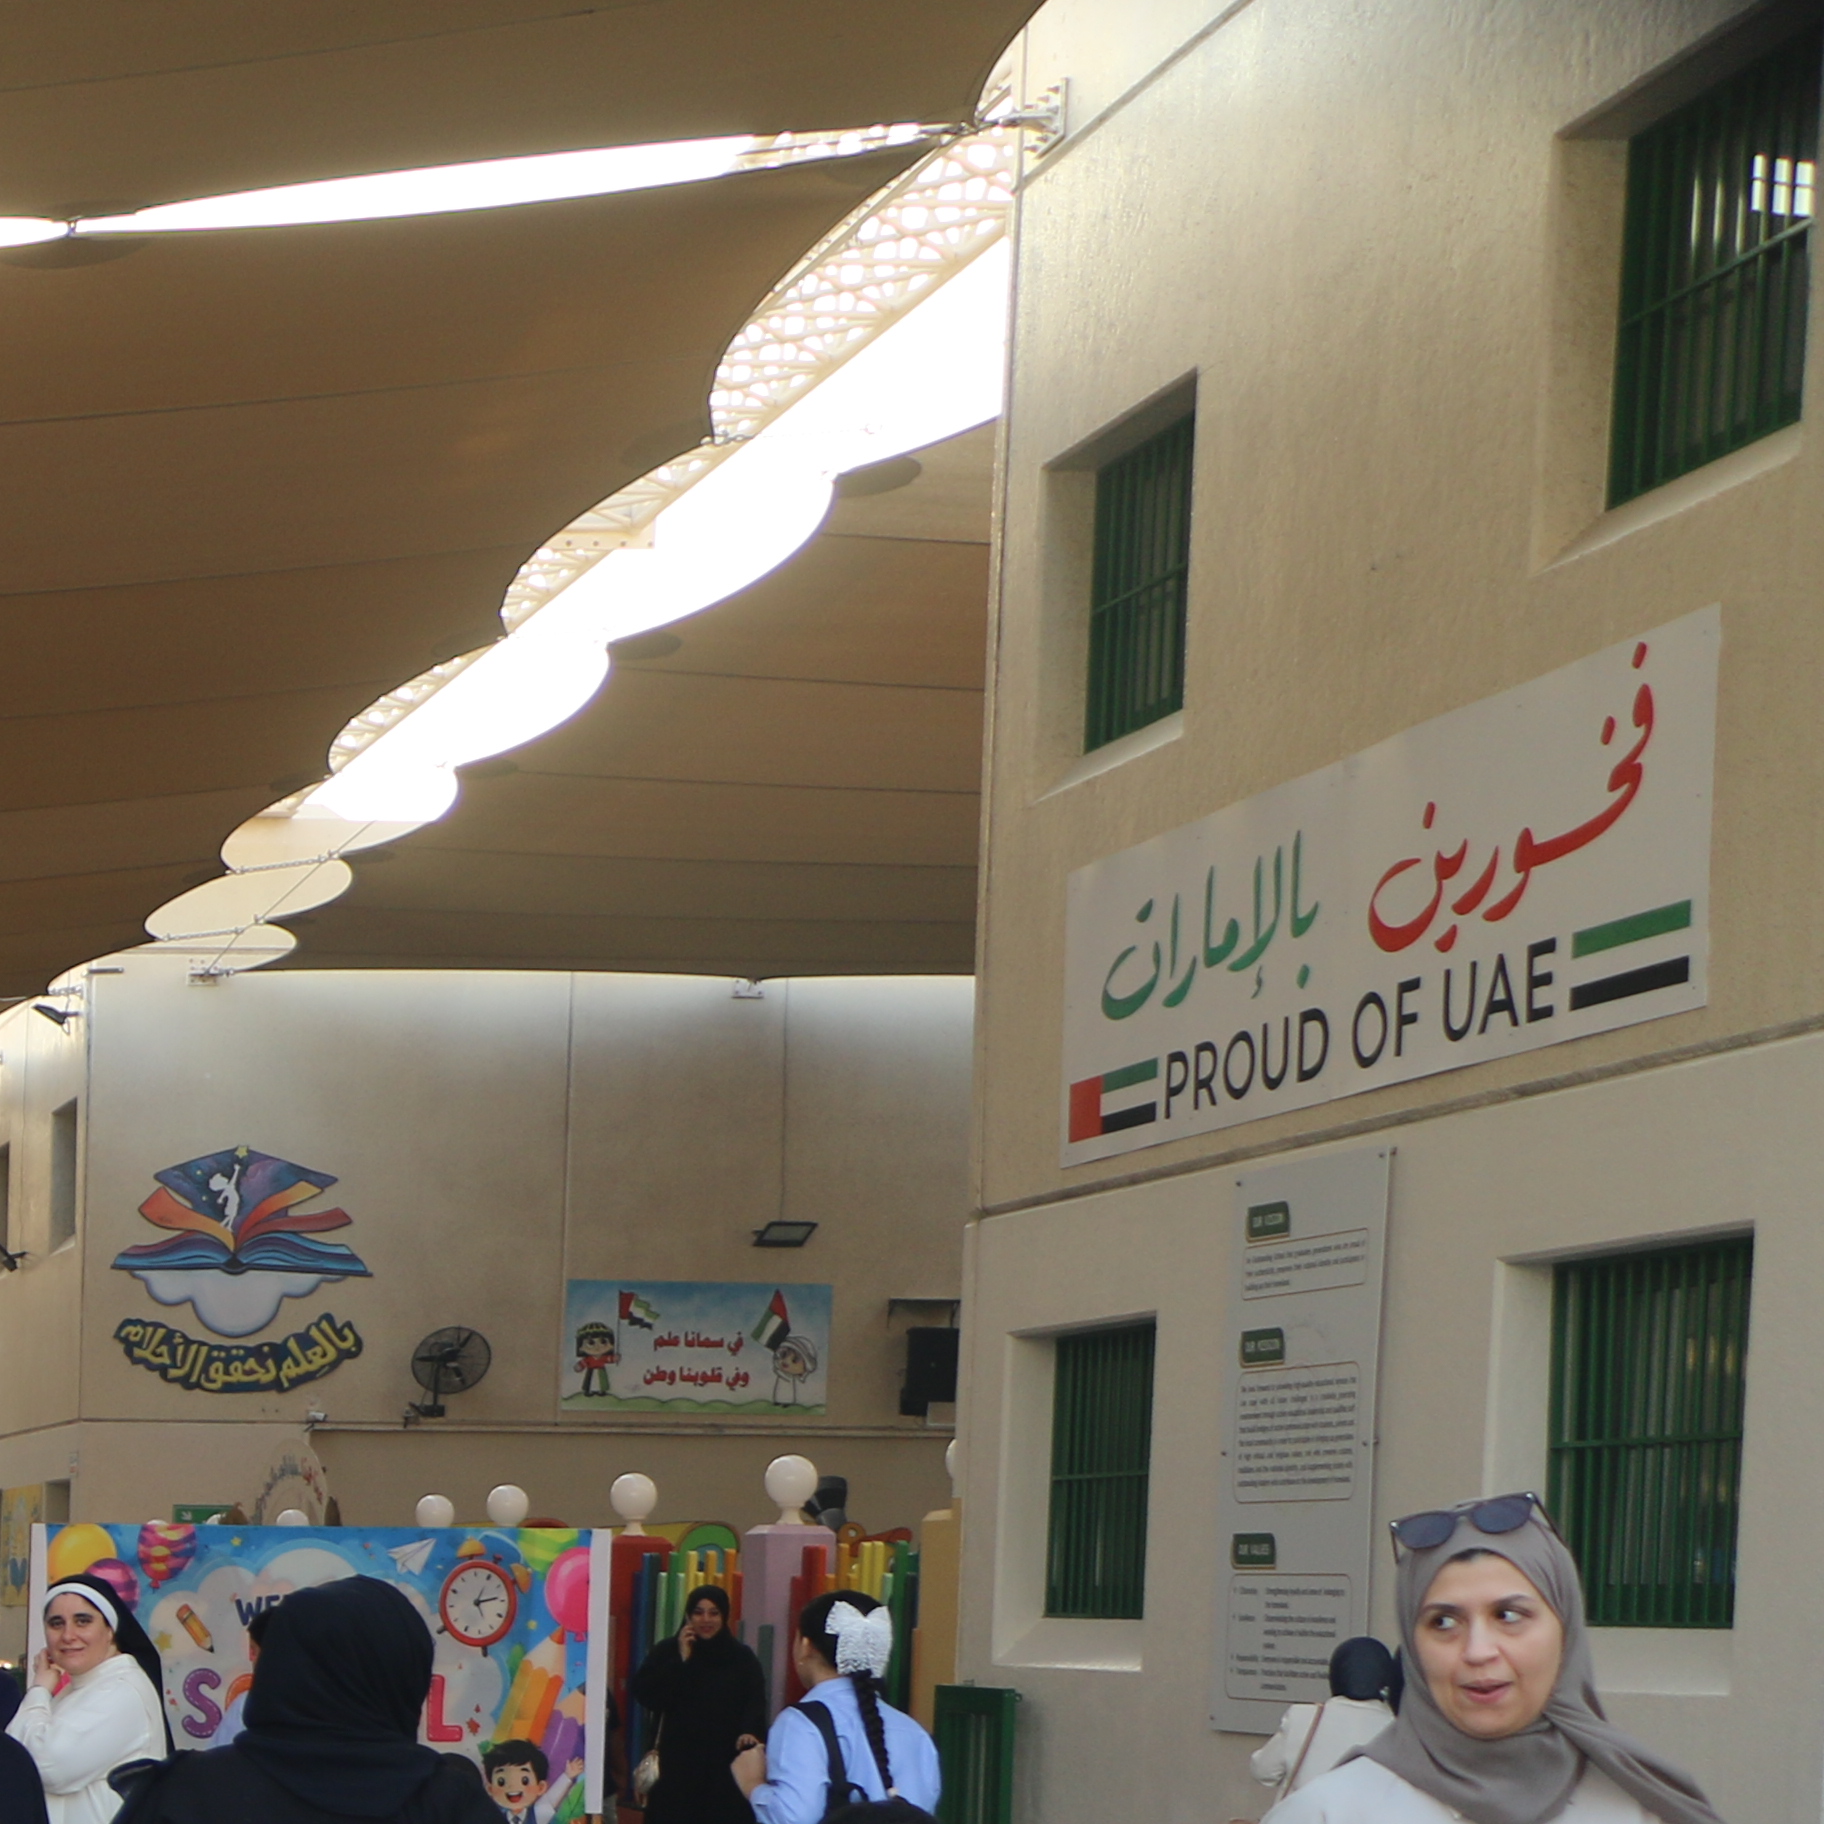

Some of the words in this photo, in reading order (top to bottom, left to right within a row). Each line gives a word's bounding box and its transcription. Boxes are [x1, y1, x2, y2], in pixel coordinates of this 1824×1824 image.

[1366, 641, 1655, 954] فخورين
[1164, 1007, 1330, 1121] PROUD
[1352, 975, 1422, 1069] OF
[1442, 936, 1558, 1043] UAE
[653, 1331, 681, 1352] علم
[727, 1331, 744, 1357] في
[202, 1345, 278, 1391] نحقق
[643, 1364, 677, 1386] وطن
[679, 1365, 723, 1388] قلوبنا
[725, 1366, 750, 1392] وفي
